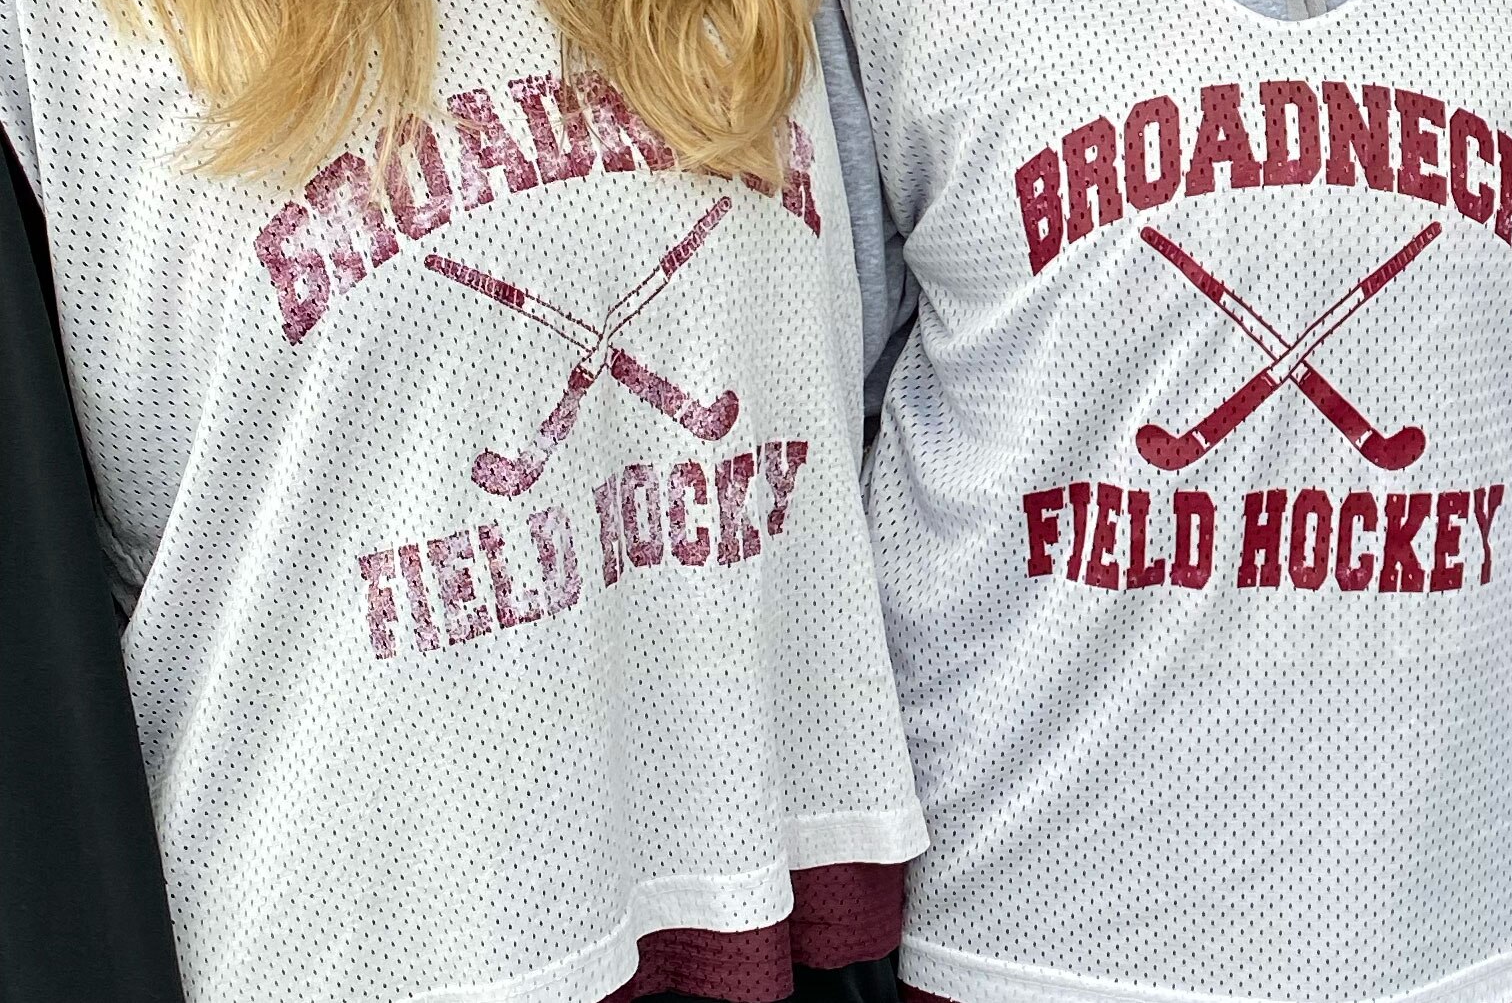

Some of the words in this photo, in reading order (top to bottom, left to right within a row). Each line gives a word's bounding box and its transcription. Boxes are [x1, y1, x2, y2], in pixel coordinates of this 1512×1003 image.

[255, 70, 822, 346] BROADNK
[358, 504, 582, 660] FIELD
[592, 440, 809, 589] HOCKY
[1022, 481, 1216, 591] FIELD
[1237, 483, 1505, 594] HOCKEY
